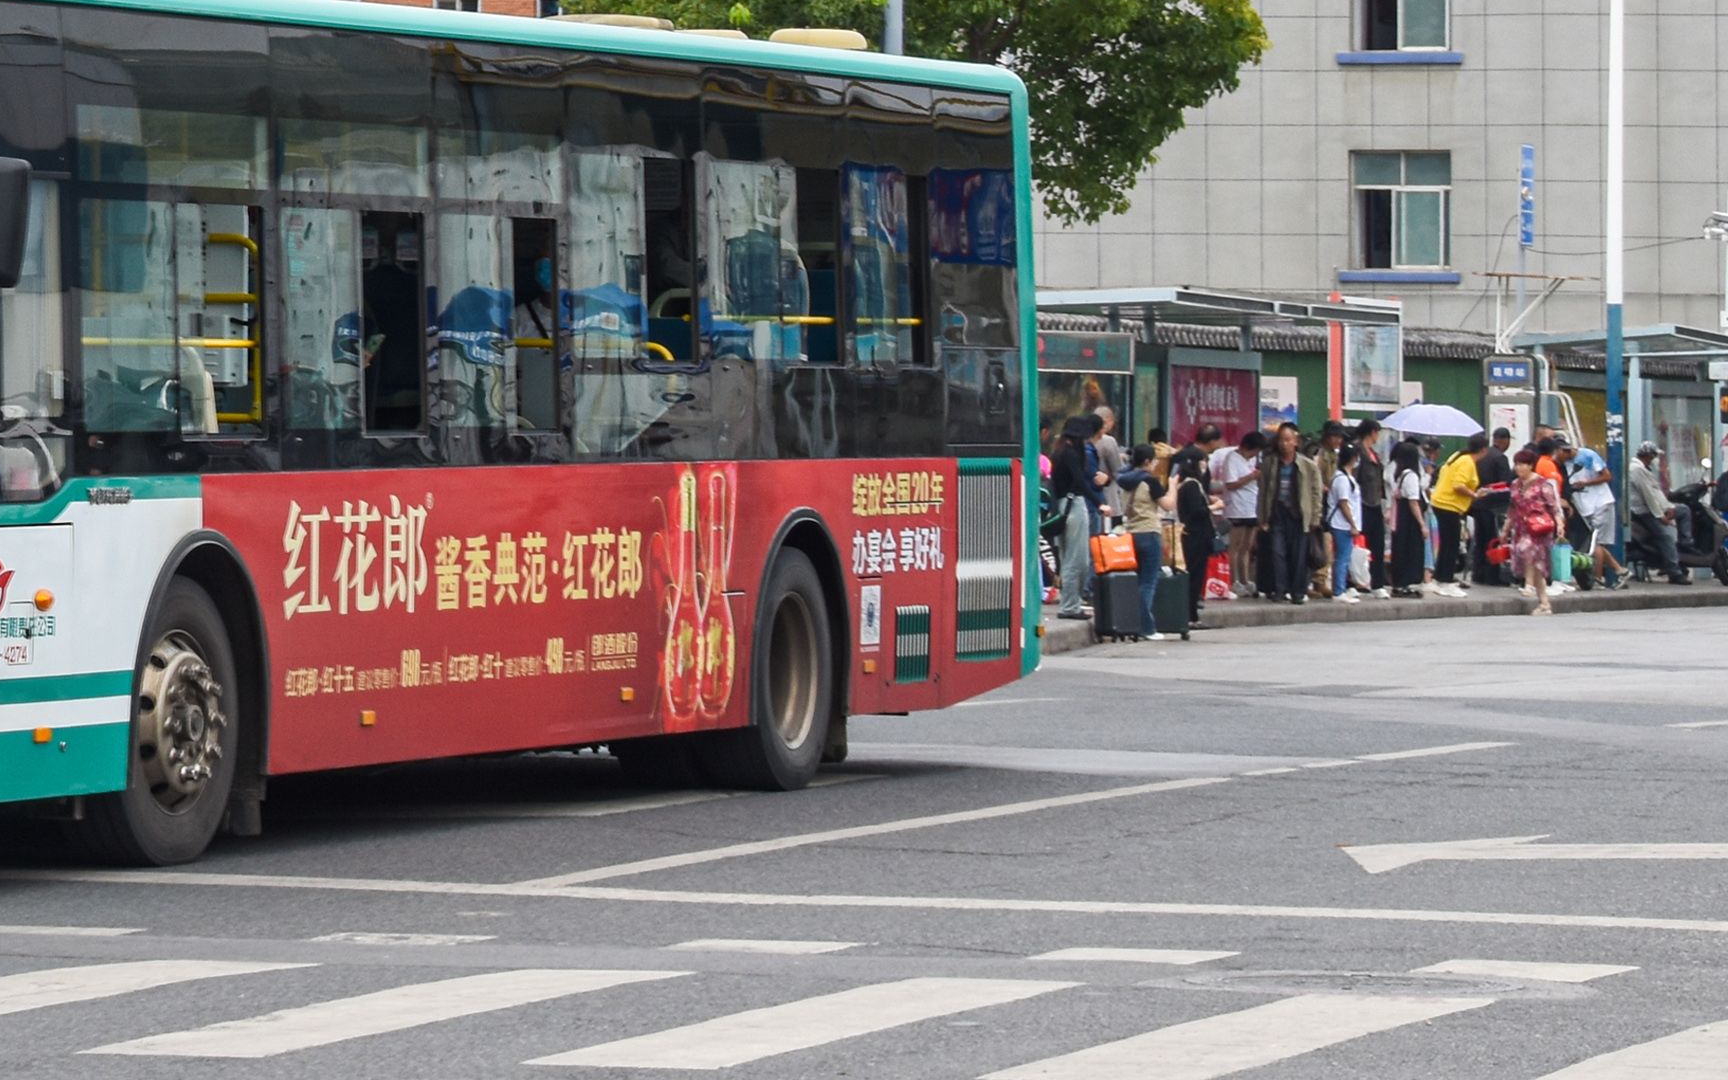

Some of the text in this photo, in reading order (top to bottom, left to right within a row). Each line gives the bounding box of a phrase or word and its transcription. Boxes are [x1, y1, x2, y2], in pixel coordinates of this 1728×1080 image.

[283, 494, 428, 620] 红花郎
[853, 526, 945, 574] 办宴会 享好礼
